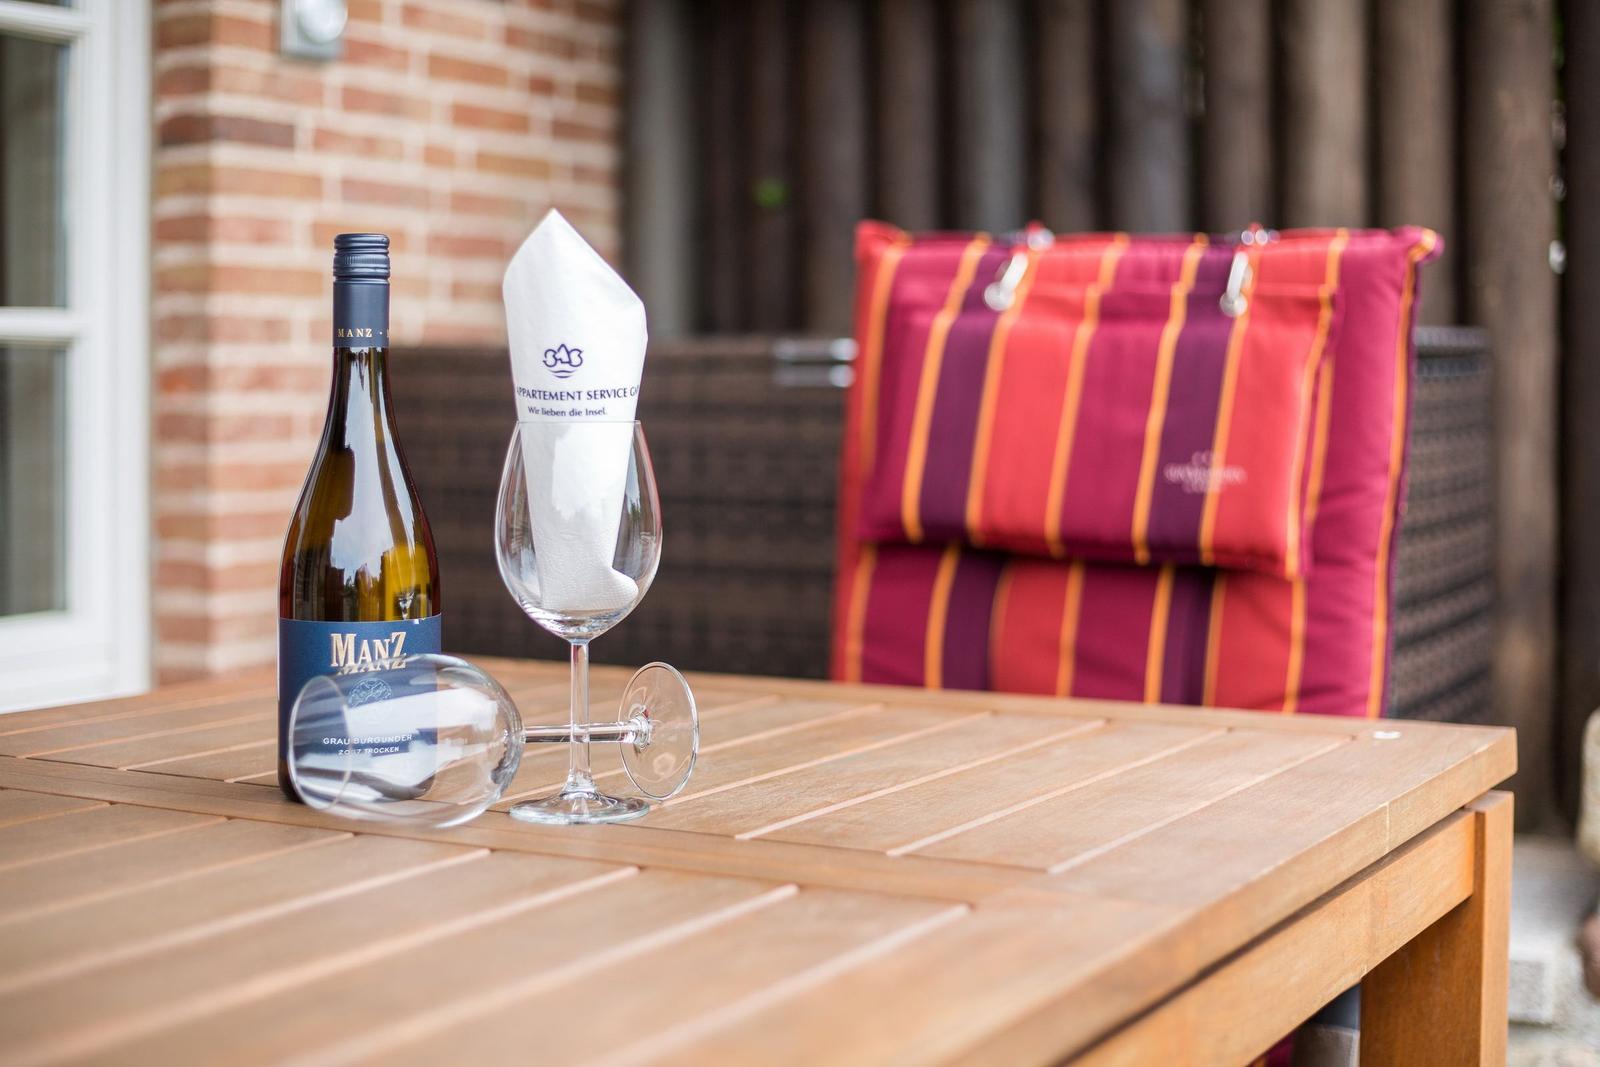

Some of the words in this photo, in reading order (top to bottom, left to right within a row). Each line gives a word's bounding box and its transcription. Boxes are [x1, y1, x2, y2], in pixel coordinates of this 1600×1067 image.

[337, 328, 373, 338] MANZ
[587, 387, 628, 400] SERVICE
[528, 406, 540, 415] Wir
[541, 407, 567, 417] lieben
[569, 408, 583, 417] die
[322, 736, 350, 746] GRAU
[353, 734, 413, 745] BURGUNDER
[364, 746, 400, 756] TROCKEN
